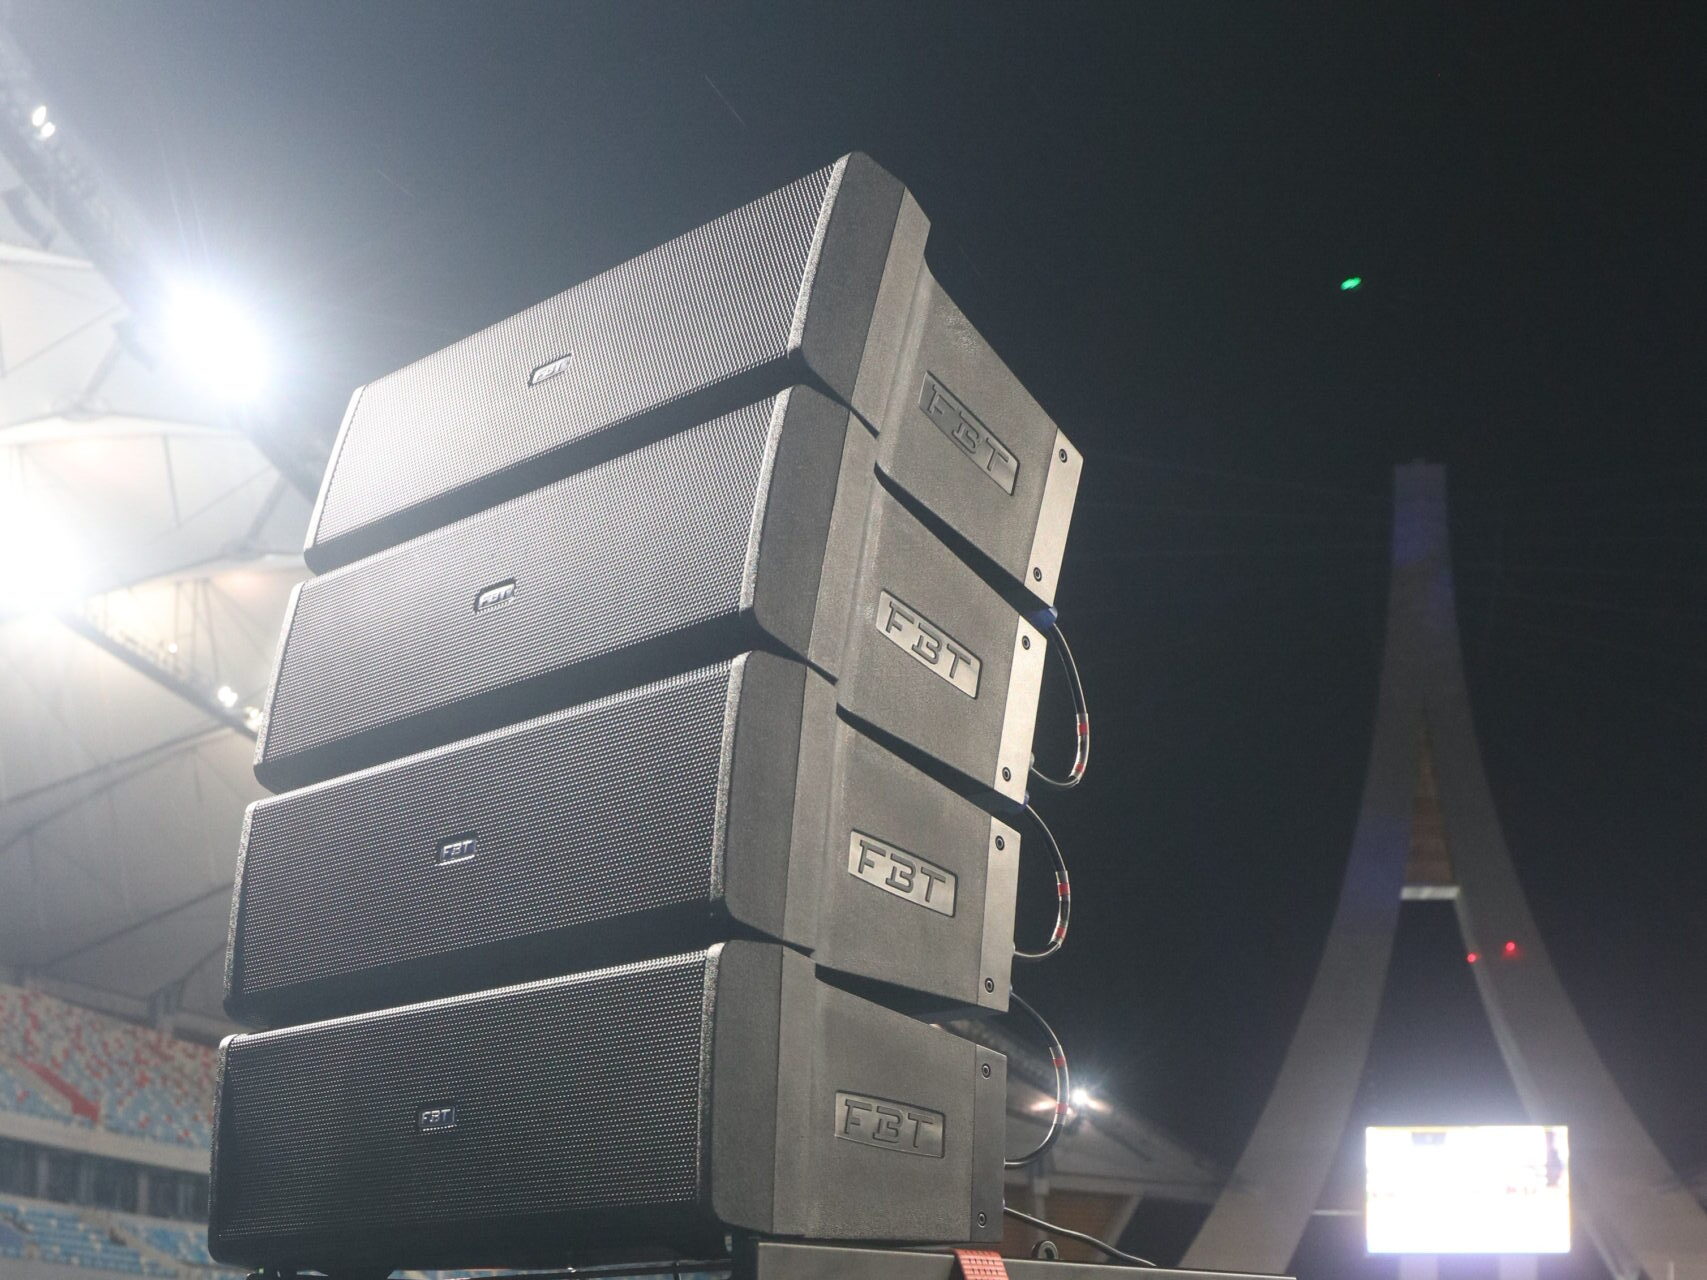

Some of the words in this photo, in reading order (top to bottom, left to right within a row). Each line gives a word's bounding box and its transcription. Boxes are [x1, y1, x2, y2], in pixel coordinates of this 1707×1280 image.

[925, 384, 1010, 473] FBT
[886, 601, 970, 678] FBT
[443, 840, 473, 857] FBT
[858, 840, 945, 903] FBT
[423, 1109, 451, 1123] FBT
[845, 1098, 933, 1149] FBT
